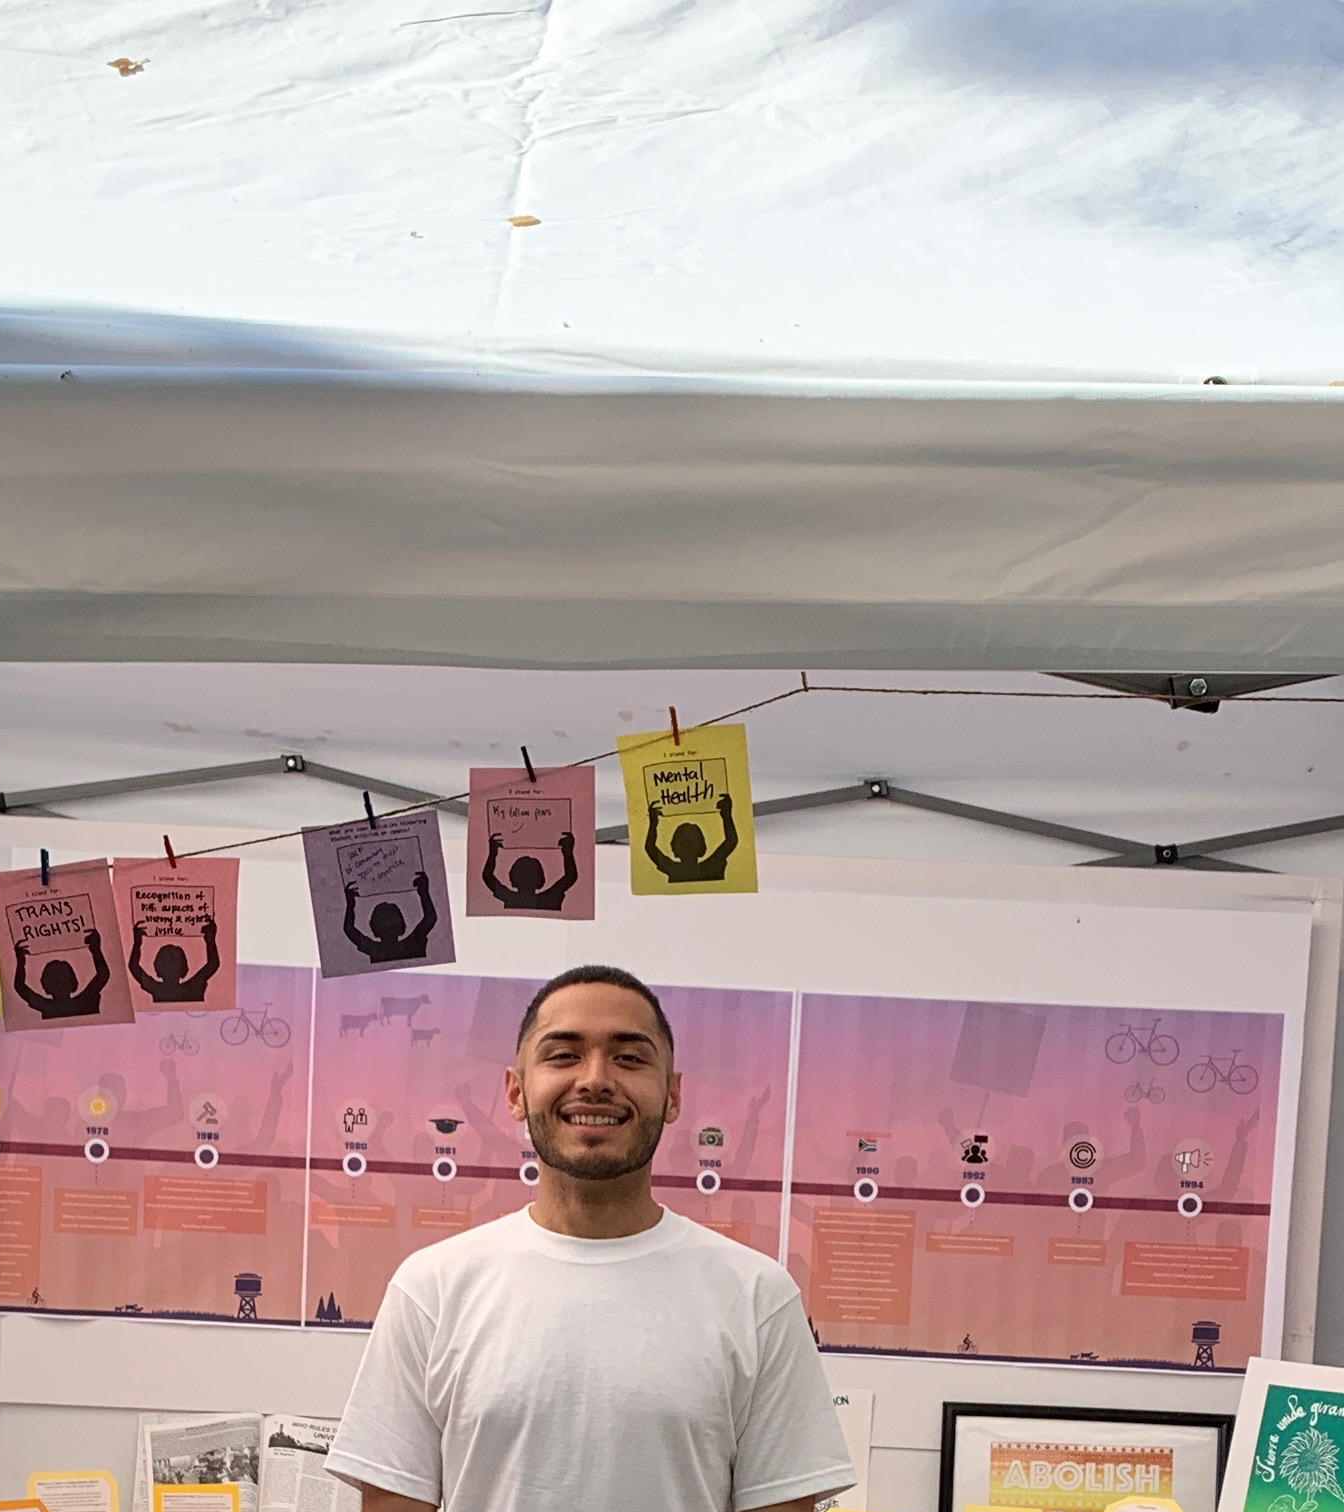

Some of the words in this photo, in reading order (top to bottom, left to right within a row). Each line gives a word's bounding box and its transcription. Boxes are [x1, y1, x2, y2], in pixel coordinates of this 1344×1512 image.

[653, 762, 704, 787] Mental
[661, 780, 714, 806] Health
[135, 890, 192, 903] Recognition
[195, 890, 205, 900] of
[161, 904, 194, 913] aspects
[198, 902, 209, 912] of
[15, 901, 74, 923] TRANS
[22, 916, 86, 940] RIGHTS!
[154, 926, 185, 936] justice
[1255, 1434, 1280, 1482] Tierra
[1002, 1460, 1160, 1493] ABOLISH
